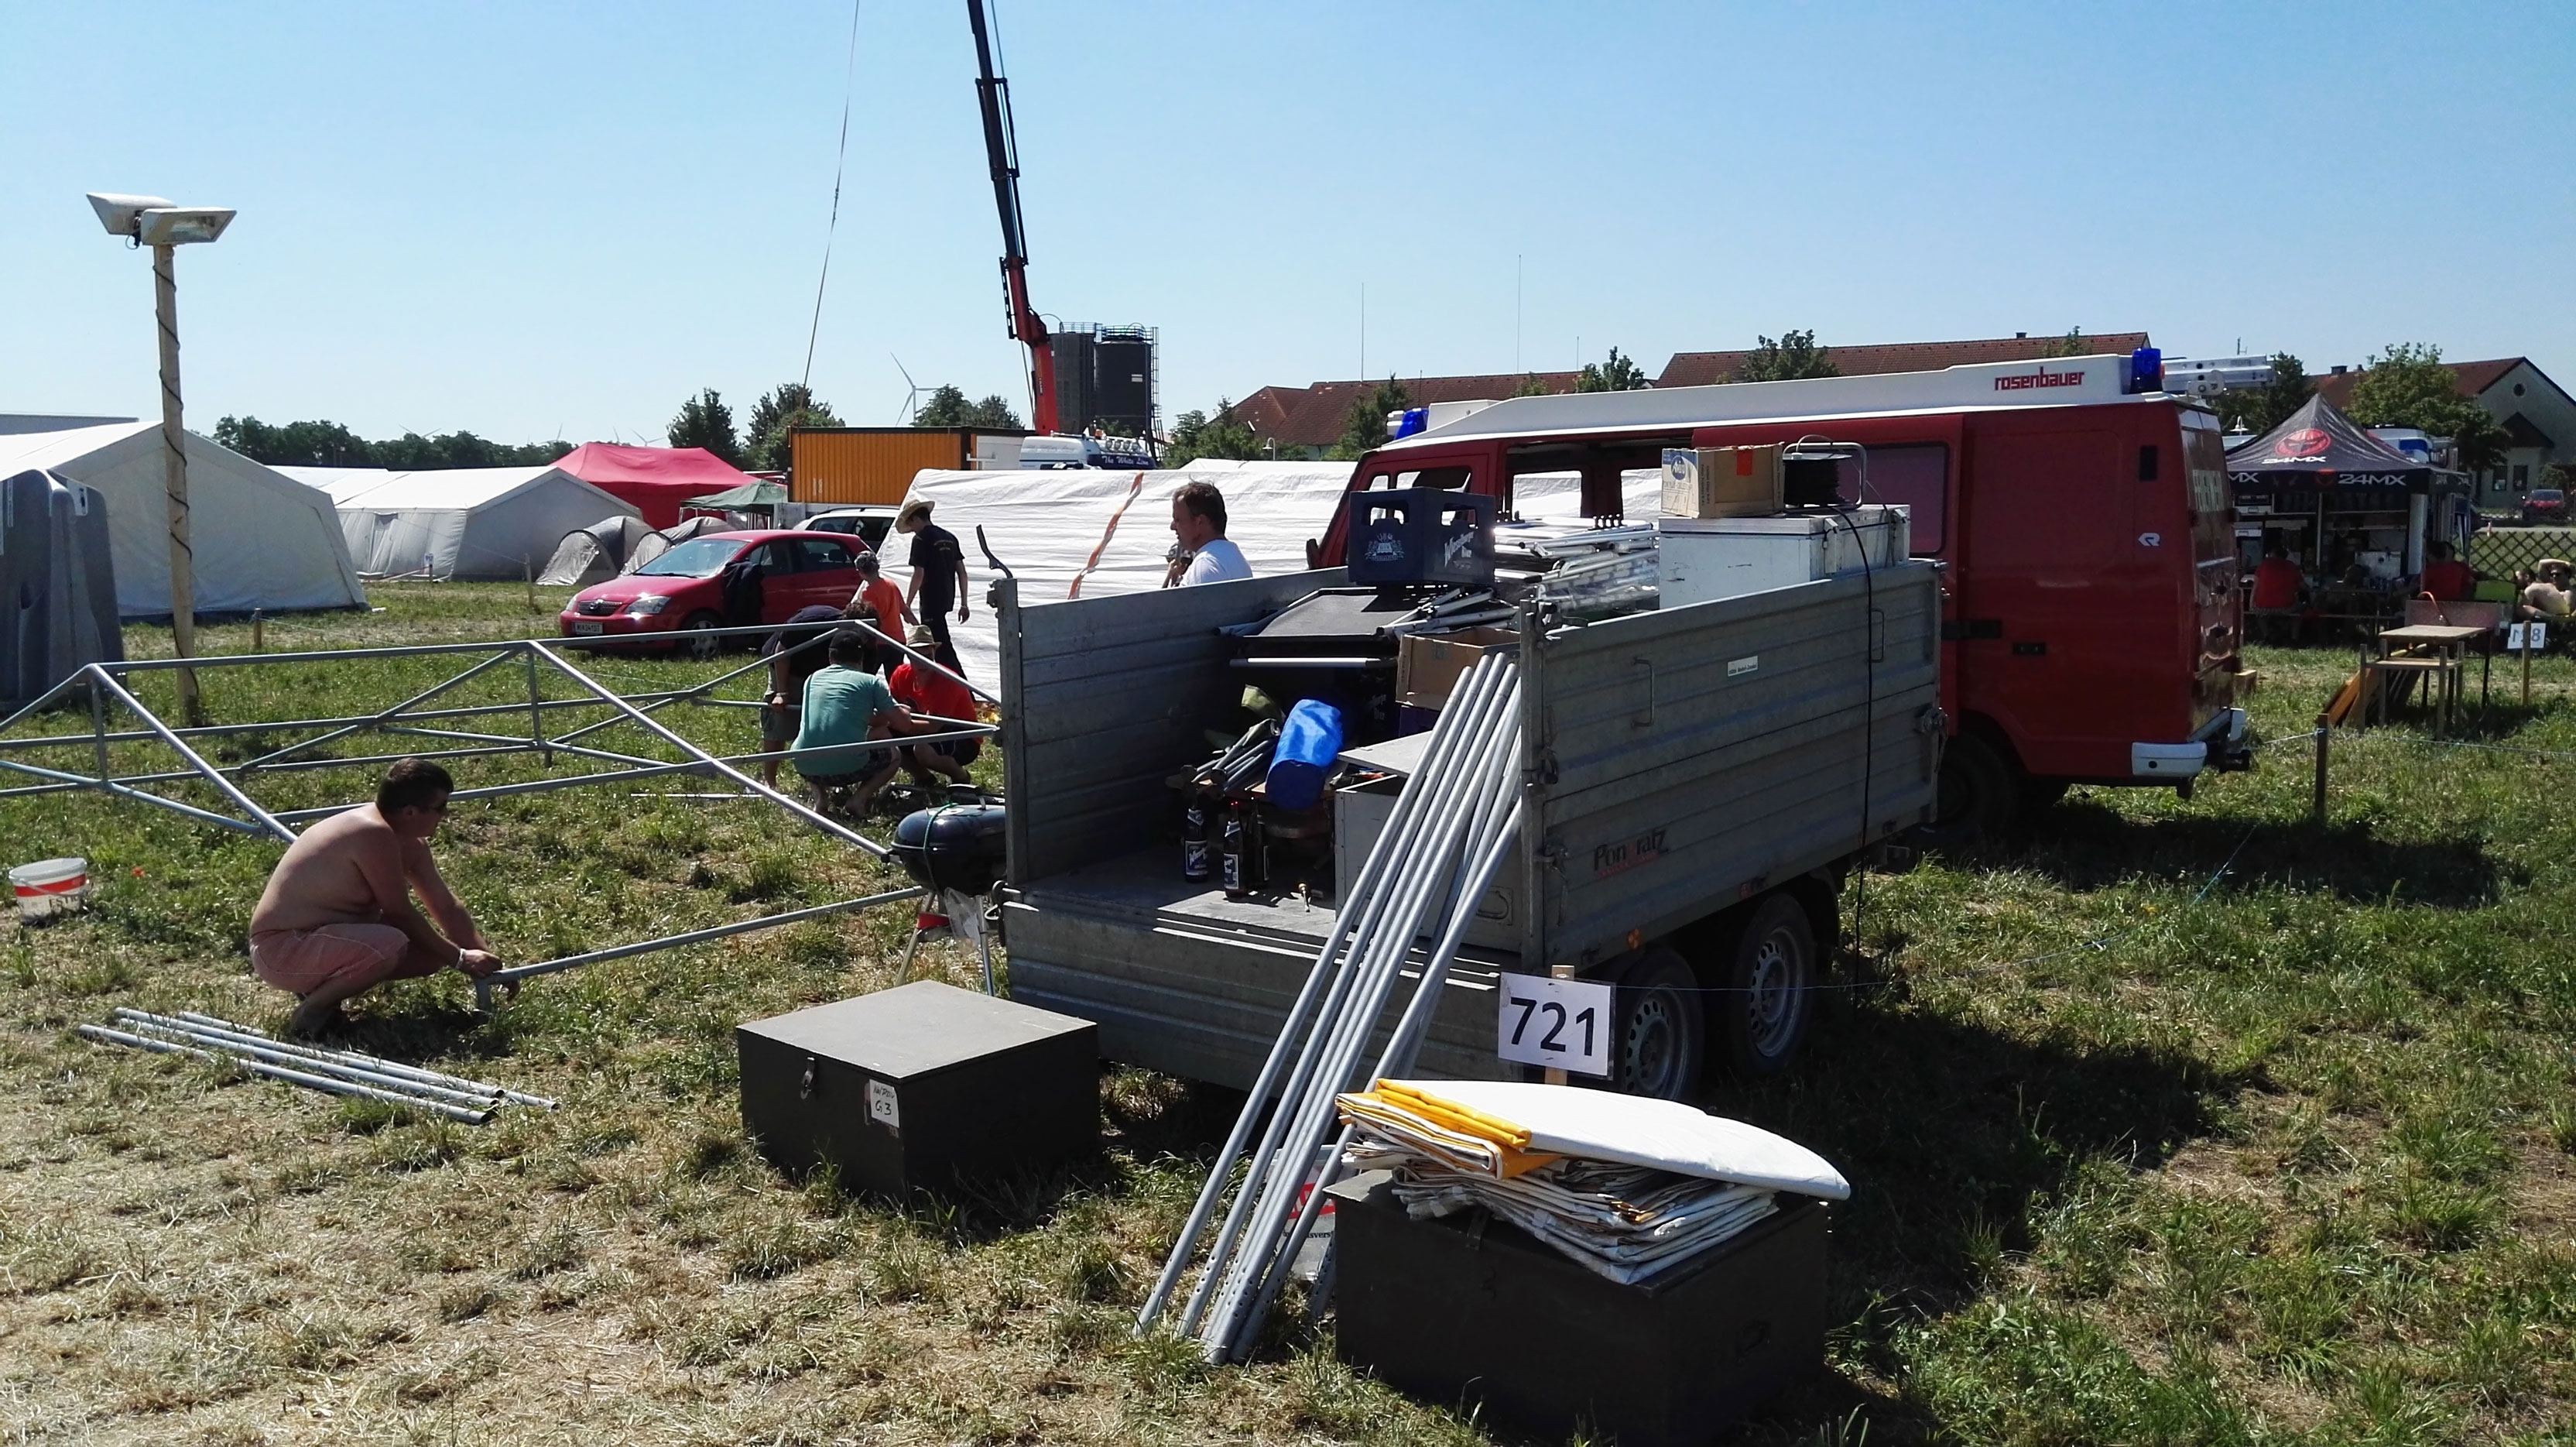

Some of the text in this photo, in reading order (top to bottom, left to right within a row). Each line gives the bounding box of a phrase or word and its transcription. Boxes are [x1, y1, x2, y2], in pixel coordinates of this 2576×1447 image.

[1994, 365, 2085, 391] rosenbauer
[1101, 455, 1115, 464] The
[2337, 473, 2407, 487] 24MX
[1594, 829, 1669, 872] Ponratz
[1510, 996, 1595, 1057] 721
